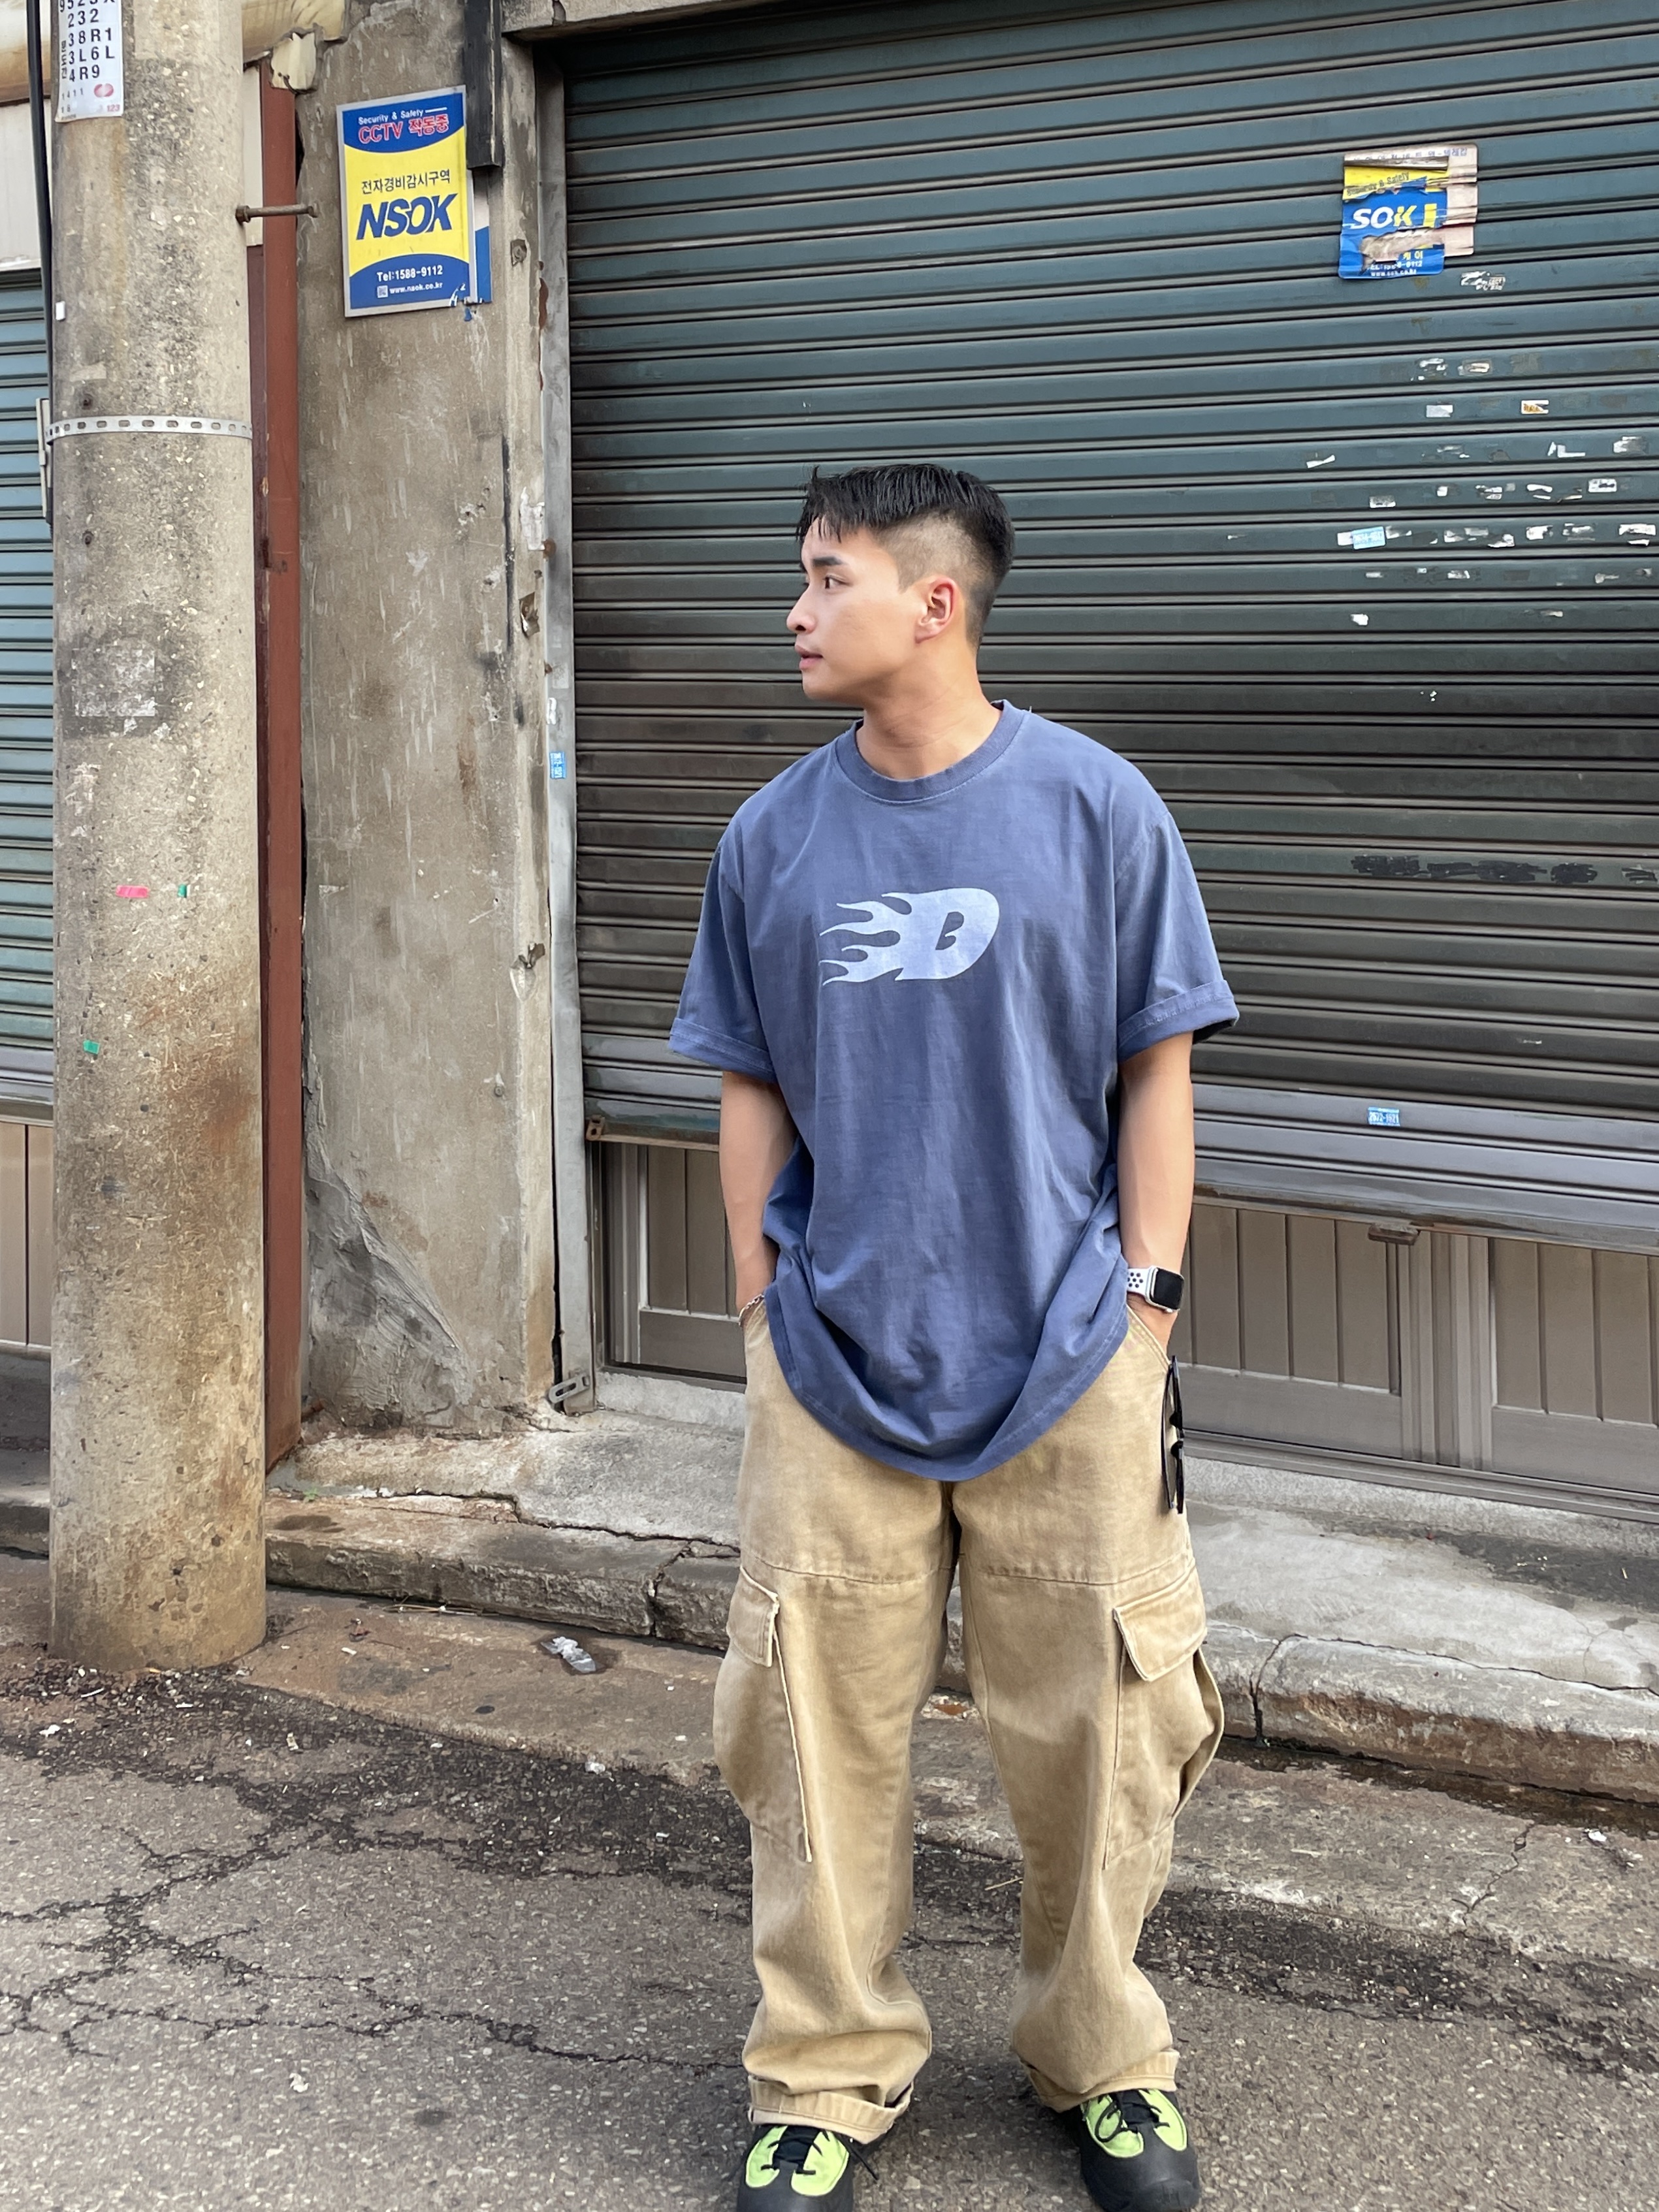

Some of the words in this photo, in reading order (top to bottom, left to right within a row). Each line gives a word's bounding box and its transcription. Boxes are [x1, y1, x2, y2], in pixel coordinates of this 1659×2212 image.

[67, 8, 99, 28] 232
[68, 27, 112, 47] 38R1
[68, 45, 115, 65] 3L6L
[69, 64, 100, 82] 4R9
[358, 114, 389, 125] Security
[392, 110, 398, 120] &
[400, 108, 424, 119] Safety
[358, 120, 404, 144] CCTV
[408, 113, 449, 136] 작동중
[361, 168, 451, 195] 전자경비감시구역
[356, 193, 459, 240] NSOK
